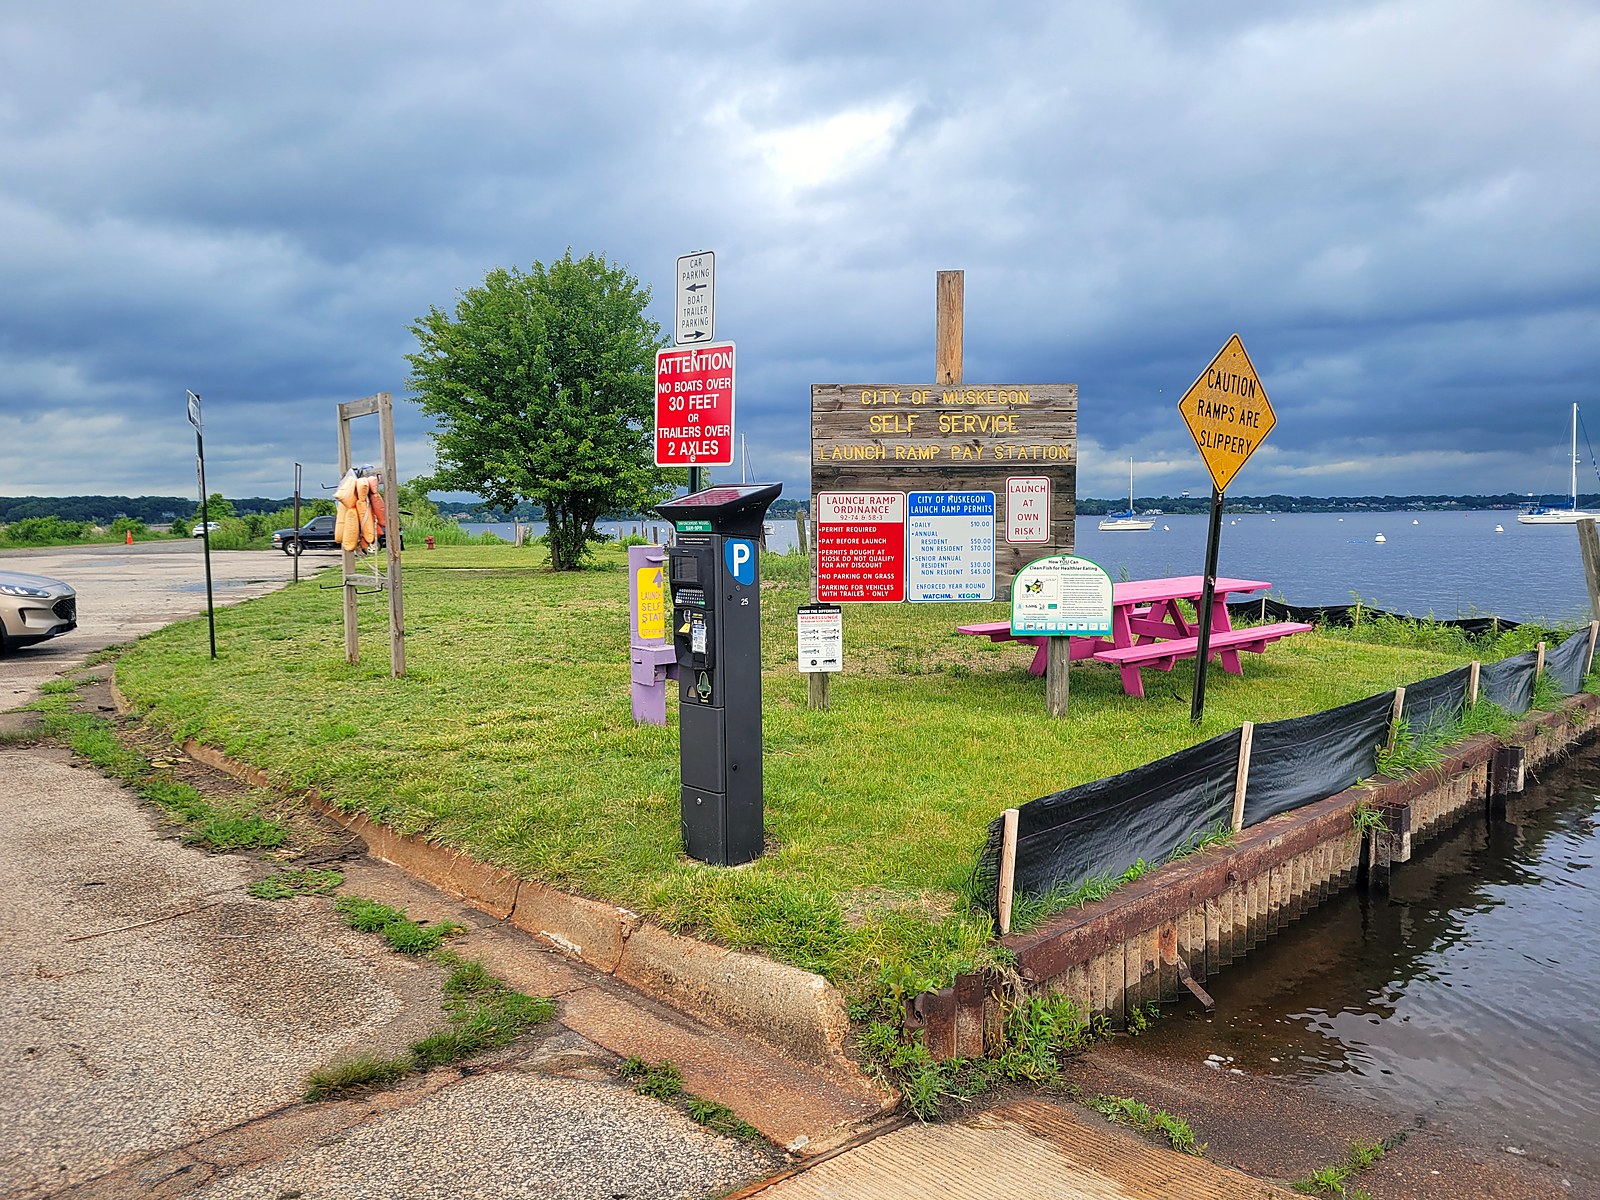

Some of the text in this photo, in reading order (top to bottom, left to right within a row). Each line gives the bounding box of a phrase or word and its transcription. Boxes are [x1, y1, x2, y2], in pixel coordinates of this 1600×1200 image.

[690, 258, 702, 268] CAR
[682, 268, 709, 280] PARKING
[688, 295, 703, 305] BOAT
[684, 306, 707, 317] TRAILER
[682, 317, 708, 328] PARKING
[659, 352, 732, 375] ATTENTION
[659, 378, 731, 394] NO BOATS OVER
[1207, 369, 1256, 398] CAUTION
[668, 394, 719, 411] 30 FEET
[862, 389, 1029, 405] CITY OF MUSKEGON
[688, 413, 699, 423] OR
[1197, 399, 1260, 428] RAMPS ARE
[659, 424, 730, 438] TRAILERS OVER
[870, 414, 1020, 433] SELF SERVICE
[668, 440, 719, 456] 2 AXLES
[1200, 430, 1252, 455] SLIPPERY
[820, 444, 1069, 460] LAUNCH RAMP PAY STATION
[918, 495, 986, 503] CITY OF MUSKEGON
[964, 505, 992, 513] PERMITS
[733, 544, 750, 576] P
[642, 602, 660, 611] SELF
